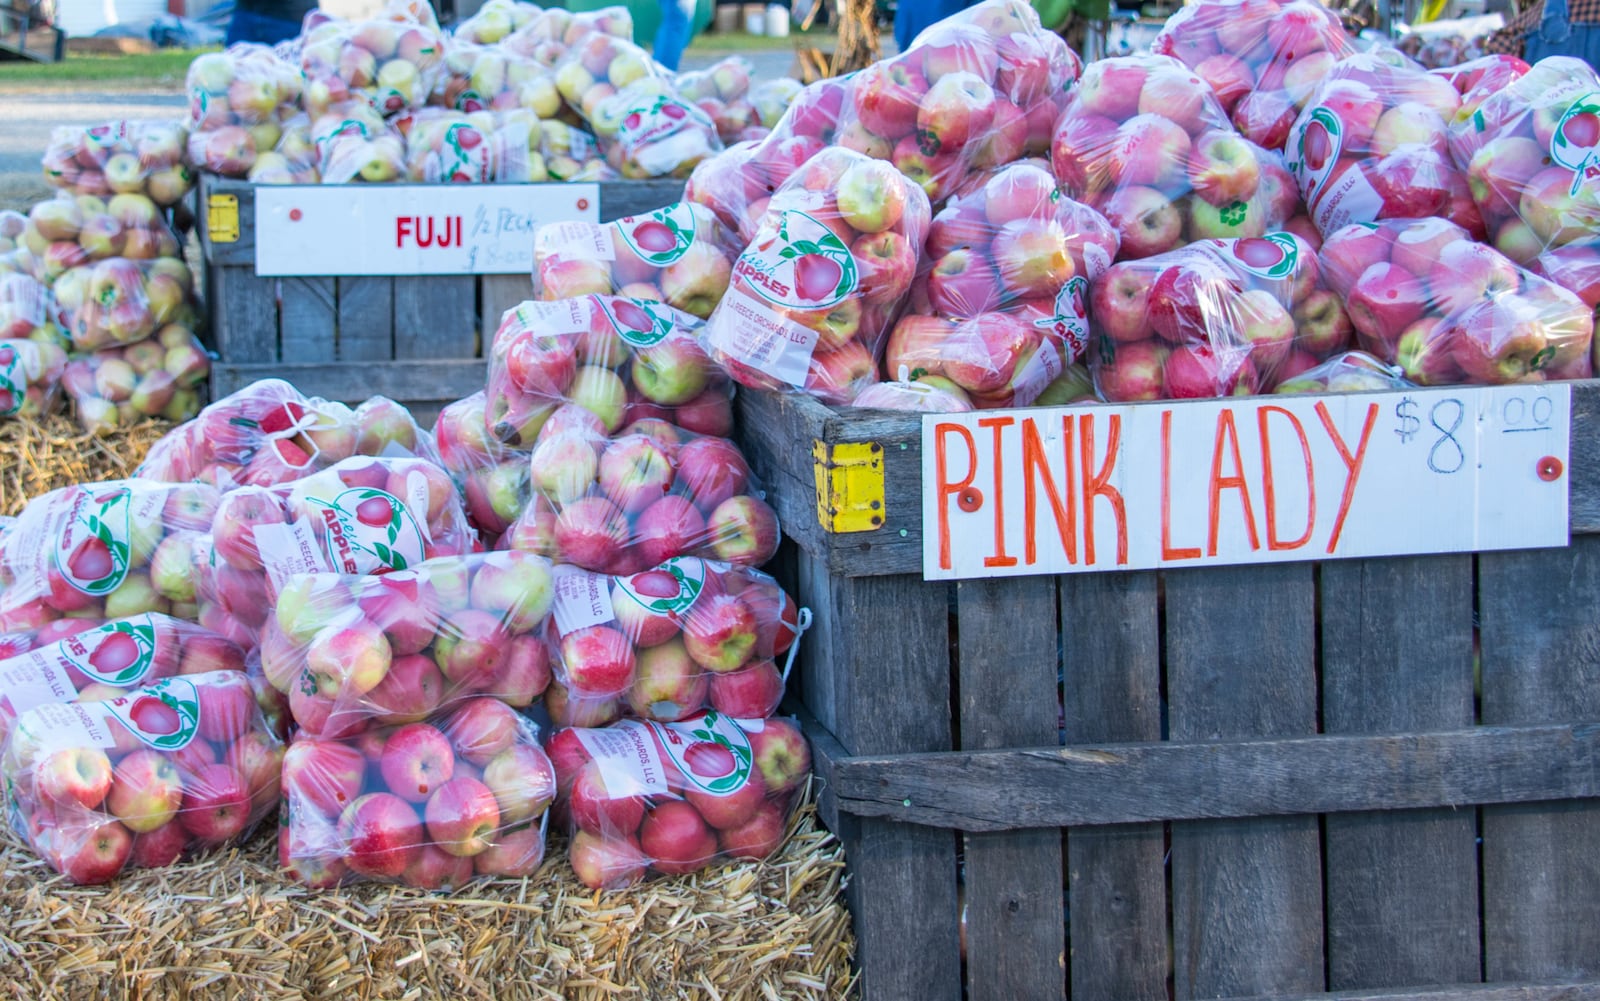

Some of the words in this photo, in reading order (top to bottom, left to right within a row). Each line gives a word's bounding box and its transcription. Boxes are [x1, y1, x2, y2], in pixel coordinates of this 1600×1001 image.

[1340, 174, 1356, 192] LLC
[396, 216, 462, 248] FUJI
[736, 260, 791, 299] APPLES
[788, 330, 807, 346] LLC
[935, 413, 1128, 570] PINK
[1161, 401, 1379, 560] LADY
[297, 539, 316, 567] REECE
[590, 602, 603, 616] LLC
[50, 682, 65, 699] LLC
[87, 726, 104, 743] LLC
[640, 765, 658, 786] LLC
